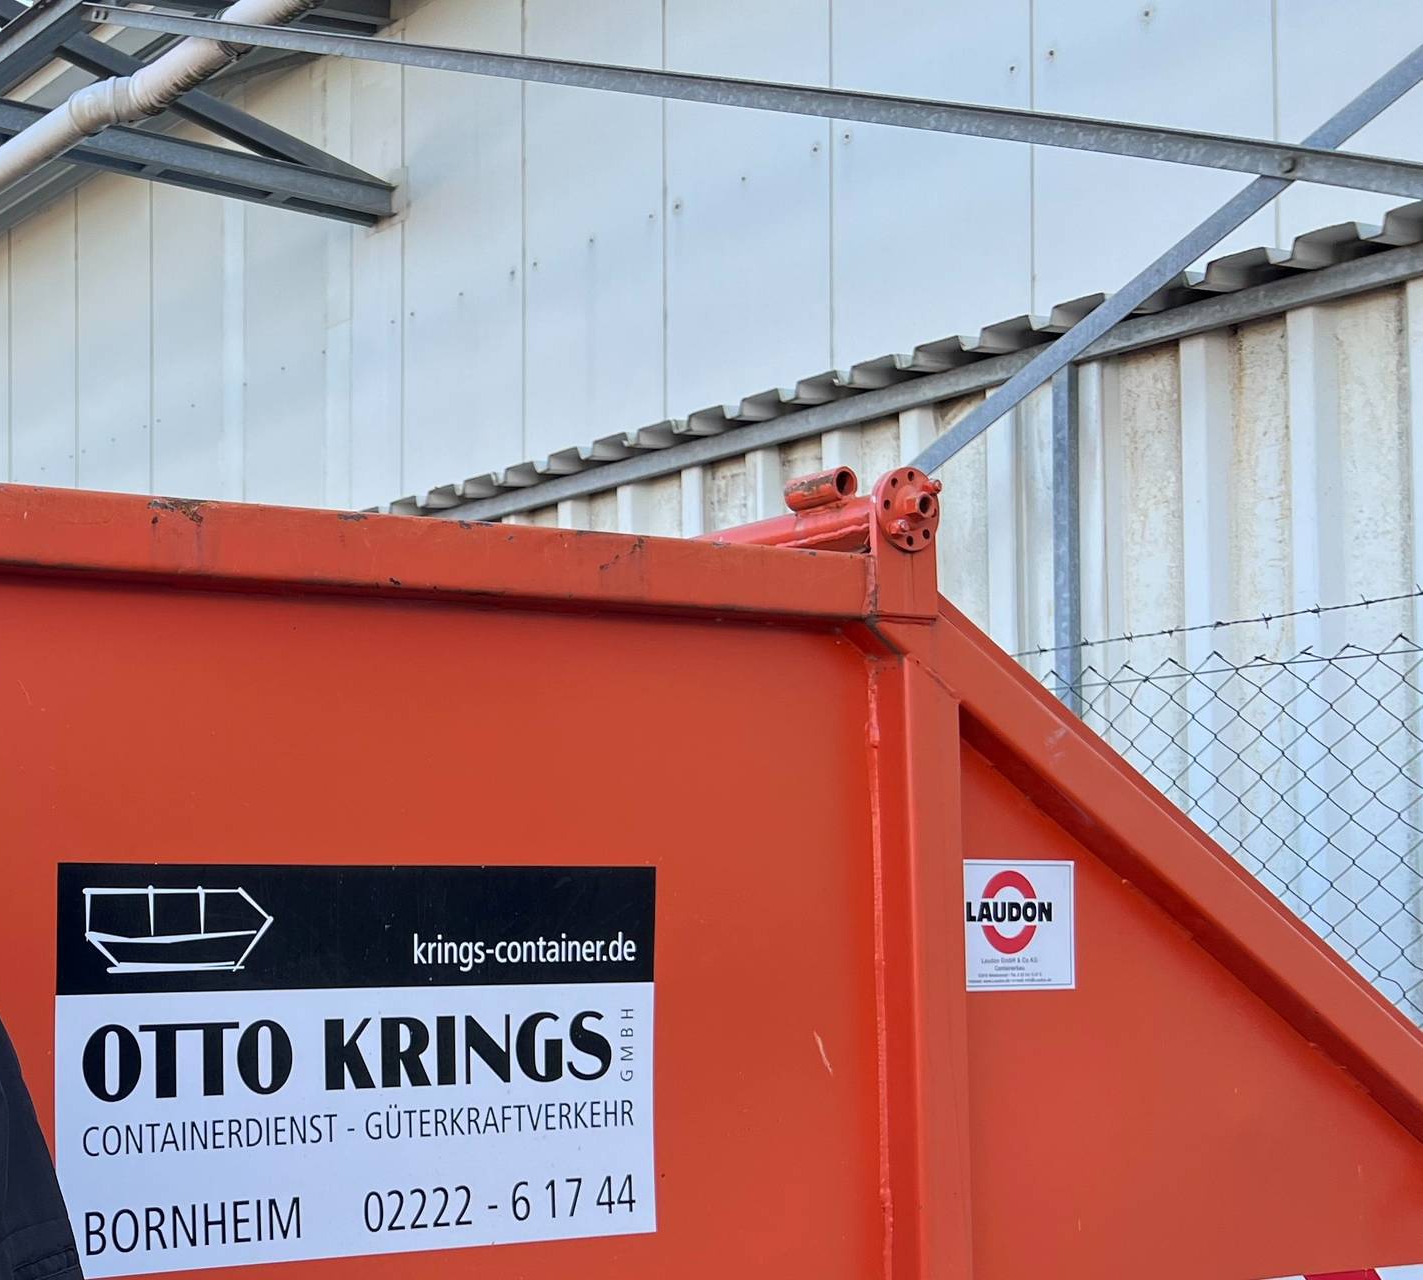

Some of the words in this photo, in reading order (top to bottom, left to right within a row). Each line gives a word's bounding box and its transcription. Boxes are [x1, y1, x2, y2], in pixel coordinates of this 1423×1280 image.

[966, 901, 1052, 922] LAUDON
[414, 932, 635, 971] krings-container.de
[82, 1020, 292, 1102] OTTO
[324, 1011, 612, 1090] KRINGS
[620, 1009, 633, 1081] GMBH
[83, 1114, 337, 1156] CONTAINERDIENST
[366, 1100, 633, 1140] GÜTERKRAFTVERKEHR
[85, 1197, 302, 1256] BORNHEIM
[364, 1185, 472, 1232] 02222
[512, 1181, 530, 1221] 6
[545, 1178, 582, 1218] 17
[596, 1174, 636, 1214] 44
